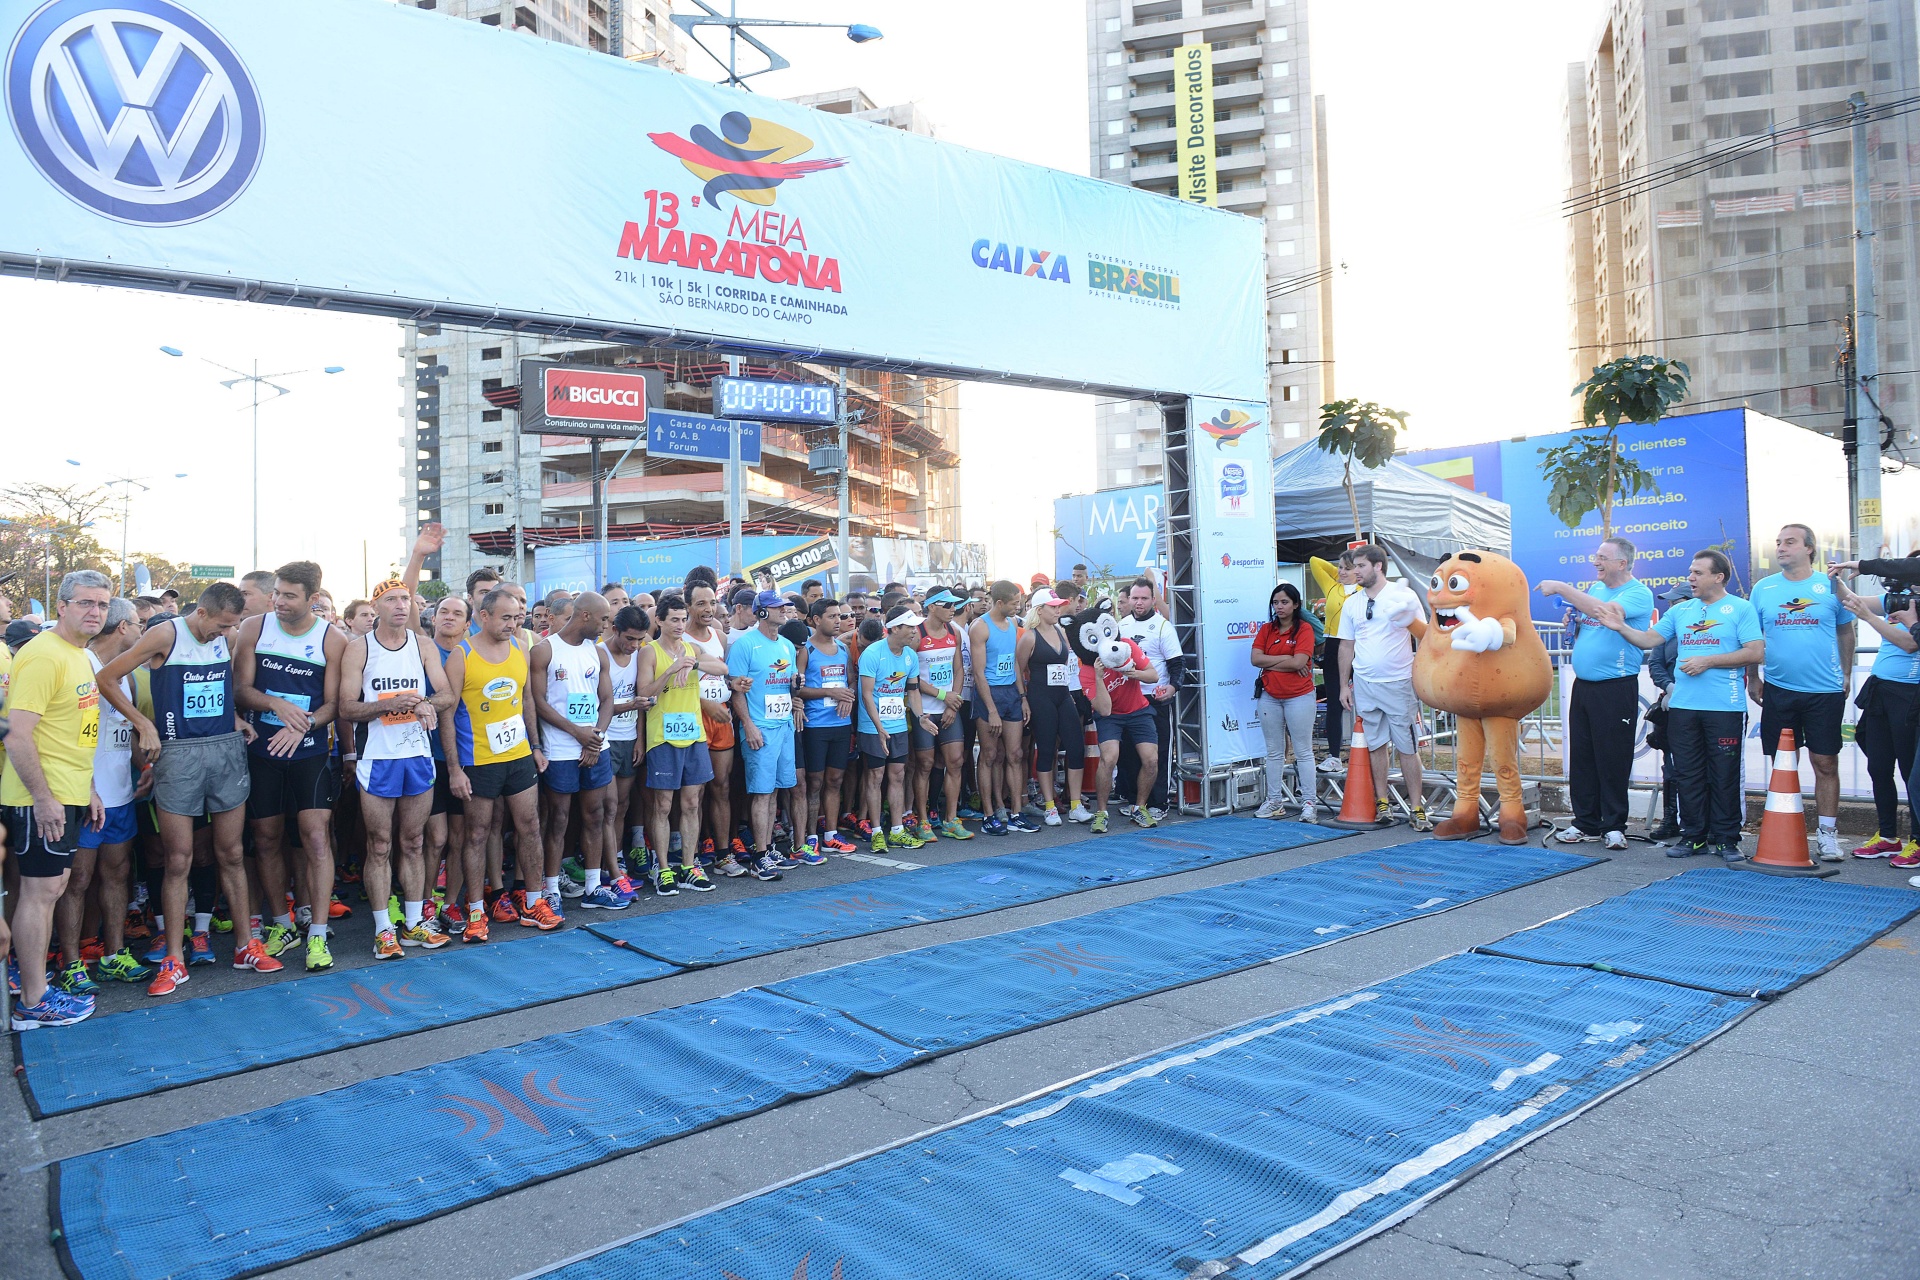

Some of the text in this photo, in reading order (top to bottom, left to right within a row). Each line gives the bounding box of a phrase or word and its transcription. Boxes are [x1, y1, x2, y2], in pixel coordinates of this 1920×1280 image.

[1185, 48, 1206, 204] Visite Decorados
[728, 204, 808, 250] MEIA
[616, 220, 843, 293] MARATONA
[971, 238, 1071, 284] CAIXA
[1087, 252, 1180, 276] GOVERNO FEDERAL
[1088, 260, 1180, 304] BRASIL
[614, 270, 848, 316] 21k 10k 5k CORRIDA E CAMINHADA
[658, 290, 813, 325] SÃO BERNARDO DO CAMPO
[1129, 296, 1181, 311] EDUCADORA
[723, 381, 831, 415] 00:00:00
[544, 418, 588, 429] Construindo
[606, 423, 621, 431] vida
[622, 424, 647, 432] melhor
[669, 419, 754, 437] Casa do Advoado
[669, 442, 699, 453] Forum
[1630, 437, 1687, 452] clientes
[1667, 467, 1685, 475] na
[1554, 529, 1571, 538] no
[1624, 519, 1688, 534] conceito
[639, 553, 672, 564] Lofts
[1559, 556, 1568, 565] e
[1570, 554, 1586, 563] na
[1667, 547, 1685, 558] de
[1774, 619, 1819, 627] MARATONA
[1680, 638, 1720, 646] MARATONA
[262, 658, 283, 671] Clube
[183, 671, 204, 682] Clube
[930, 669, 951, 682] 5037
[371, 677, 419, 691] Gilson
[704, 688, 722, 699] 151
[1730, 680, 1738, 704] Think
[186, 693, 224, 709] 5018
[767, 702, 790, 713] 1372
[569, 703, 595, 715] 5721
[880, 704, 903, 715] 2609
[665, 722, 695, 733] 5034
[495, 728, 517, 745] 137
